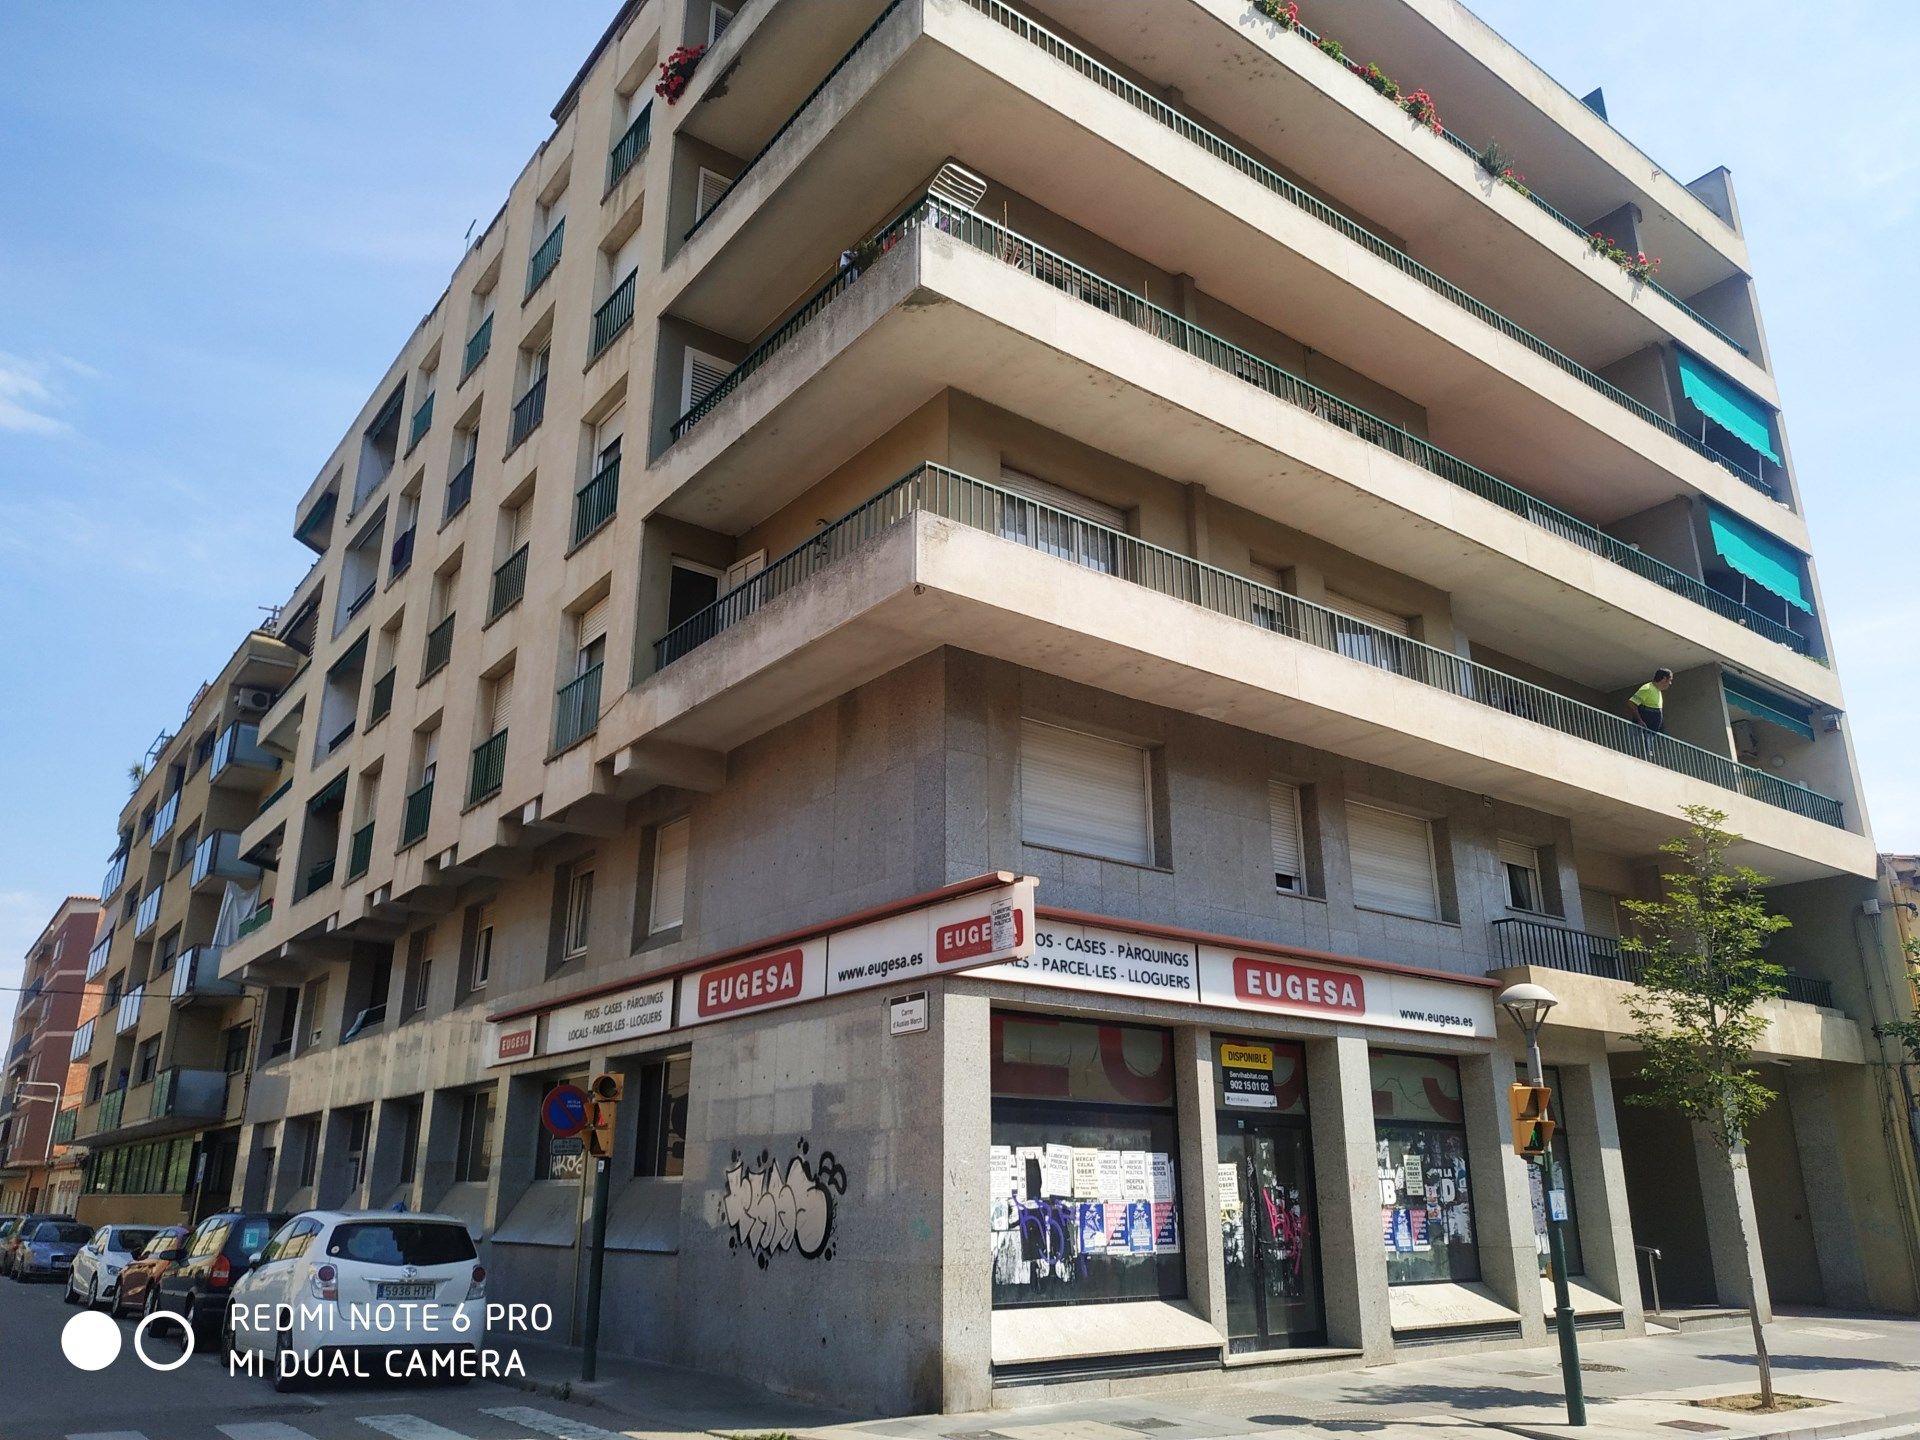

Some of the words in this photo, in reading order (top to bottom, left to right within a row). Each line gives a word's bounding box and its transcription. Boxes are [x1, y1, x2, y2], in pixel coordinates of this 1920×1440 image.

[944, 922, 1017, 950] EUGE
[1066, 937, 1106, 956] CASES
[1118, 942, 1189, 967] PÀRQUINGS
[838, 952, 923, 982] www.eugesa.es
[707, 962, 794, 1007] EUGESA
[1128, 969, 1190, 990] LLOGUERS
[1246, 969, 1357, 1008] EUGESA
[584, 1006, 600, 1021] PISOS
[604, 1001, 622, 1016] CASES
[627, 991, 664, 1012] PÀRQUINGS
[568, 1025, 589, 1042] LOCALS
[630, 1010, 662, 1028] LLOGUERS
[1400, 1009, 1473, 1028] www.eugesa.es
[502, 1034, 530, 1051] EUGESA
[1228, 1051, 1268, 1064] DISPONIBLE
[1229, 1070, 1269, 1081] Servihabitat.com
[1230, 1079, 1243, 1090] 902
[1243, 1081, 1252, 1091] 15
[1251, 1081, 1260, 1091] 01
[1260, 1082, 1270, 1092] 02
[384, 1283, 411, 1296] 5936
[413, 1284, 433, 1296] HTP
